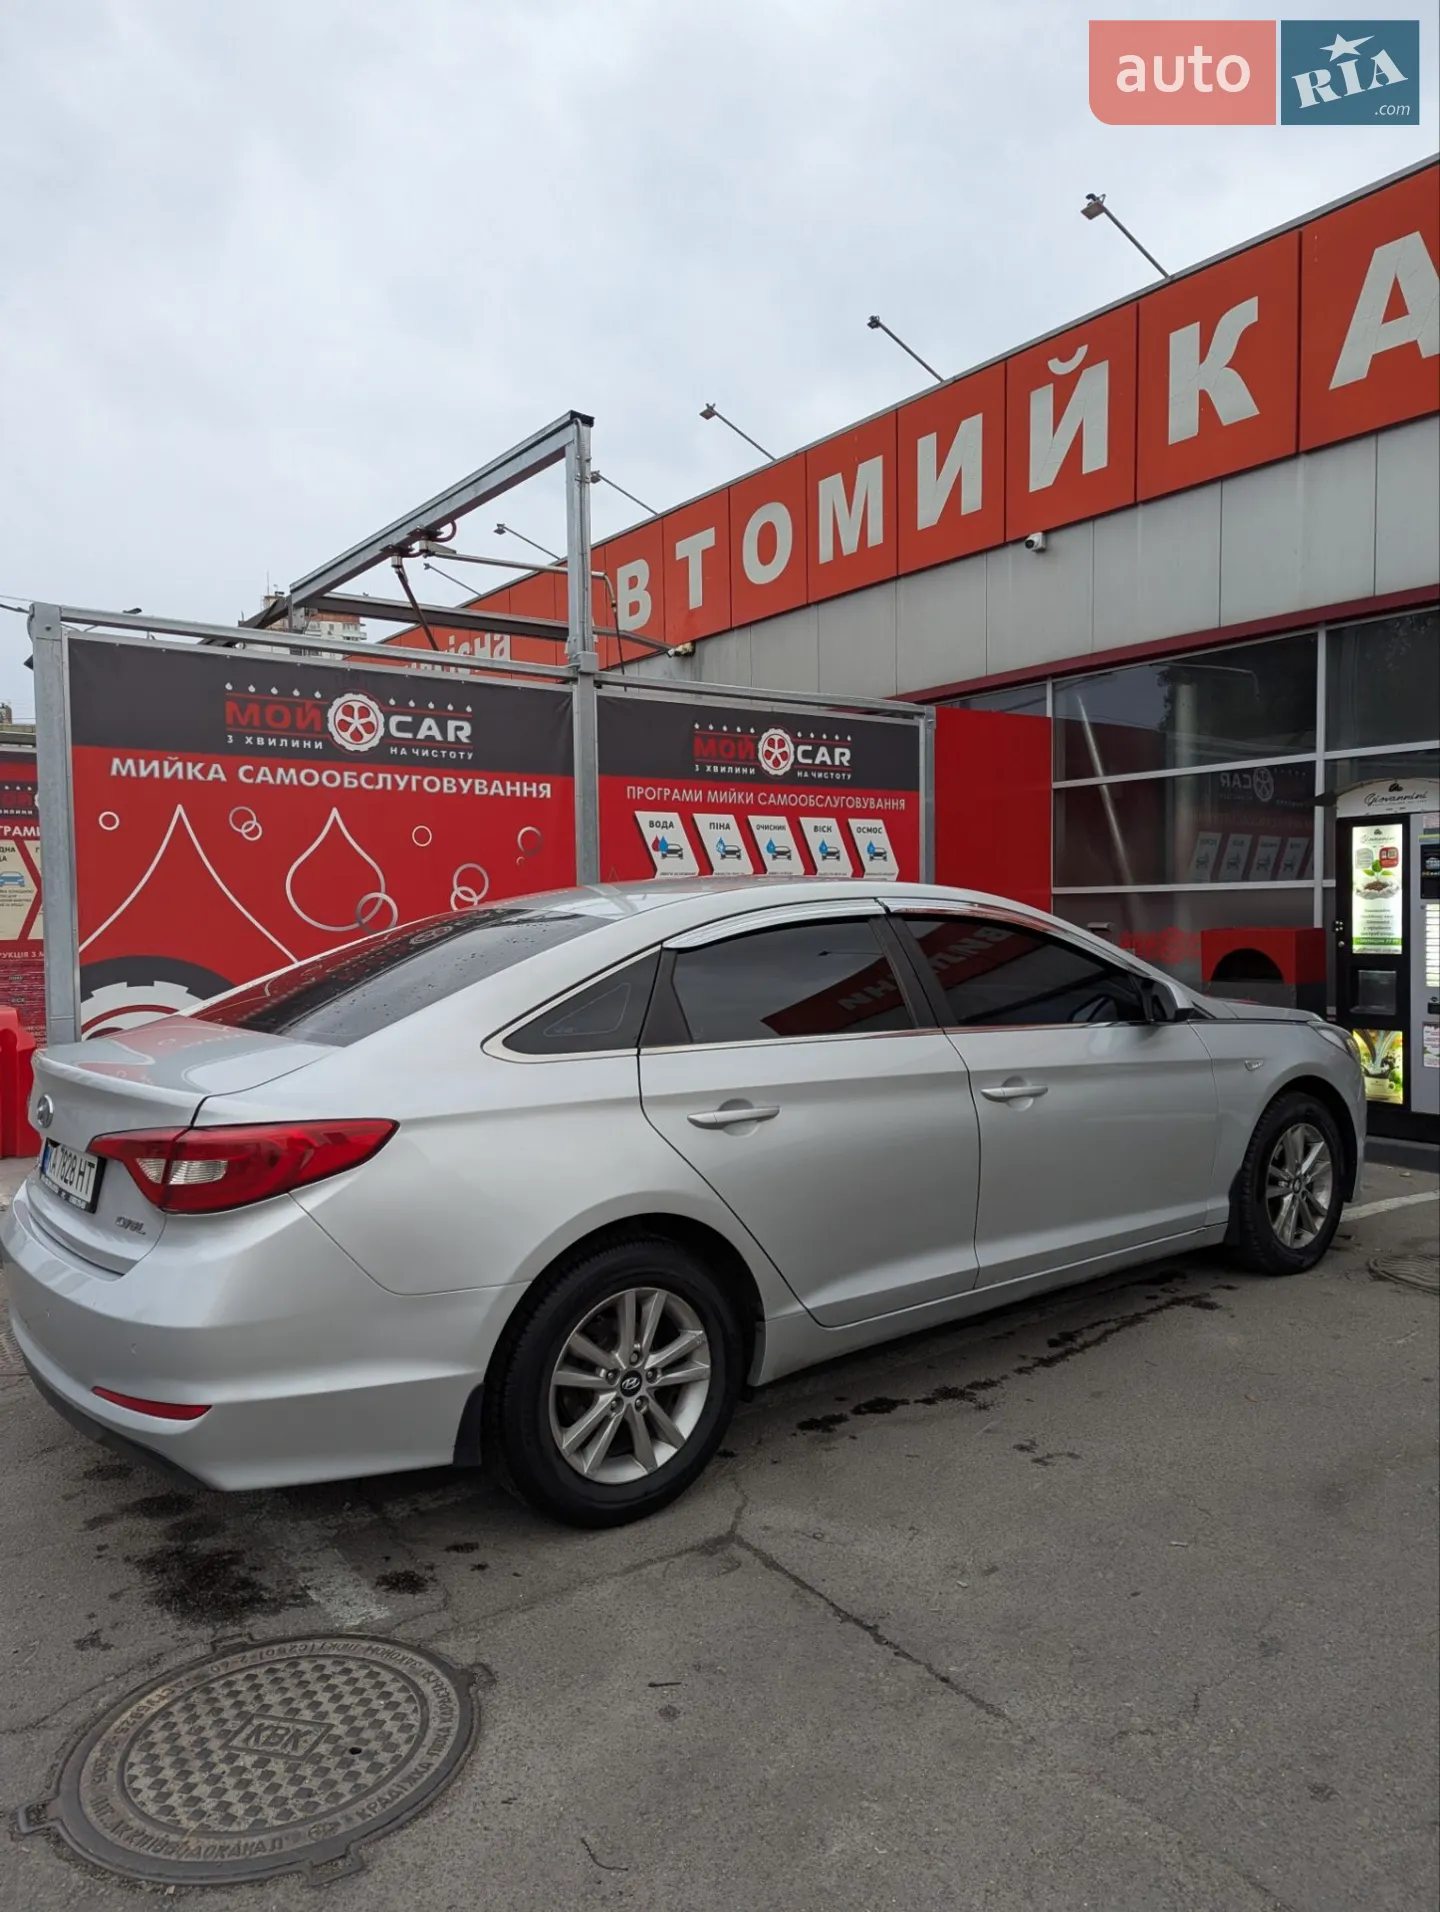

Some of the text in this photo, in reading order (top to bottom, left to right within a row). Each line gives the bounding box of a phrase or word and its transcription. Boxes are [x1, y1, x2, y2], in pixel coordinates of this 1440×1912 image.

[566, 231, 1440, 657] ВТОМИЙКА
[225, 700, 472, 743] МОЙ CAR
[245, 735, 324, 750] ХВИЛИНИ
[412, 747, 474, 760] ЧИСТОТУ
[694, 735, 851, 767] МОЙ CAR
[110, 756, 552, 799] МИЙКА САМООБСЛУГОВУВАННЯ
[706, 765, 756, 775] ХВИЛИНИ
[626, 785, 906, 811] ПРОГРАМИ МИЙКИ САМООБСЛУГОВУВАННЯ
[648, 820, 675, 830] ВОДА
[709, 822, 731, 831] ПІНА
[755, 823, 787, 832] ОЧИСНИК
[813, 825, 833, 834] ВІСК
[856, 827, 883, 835] ОСМОС
